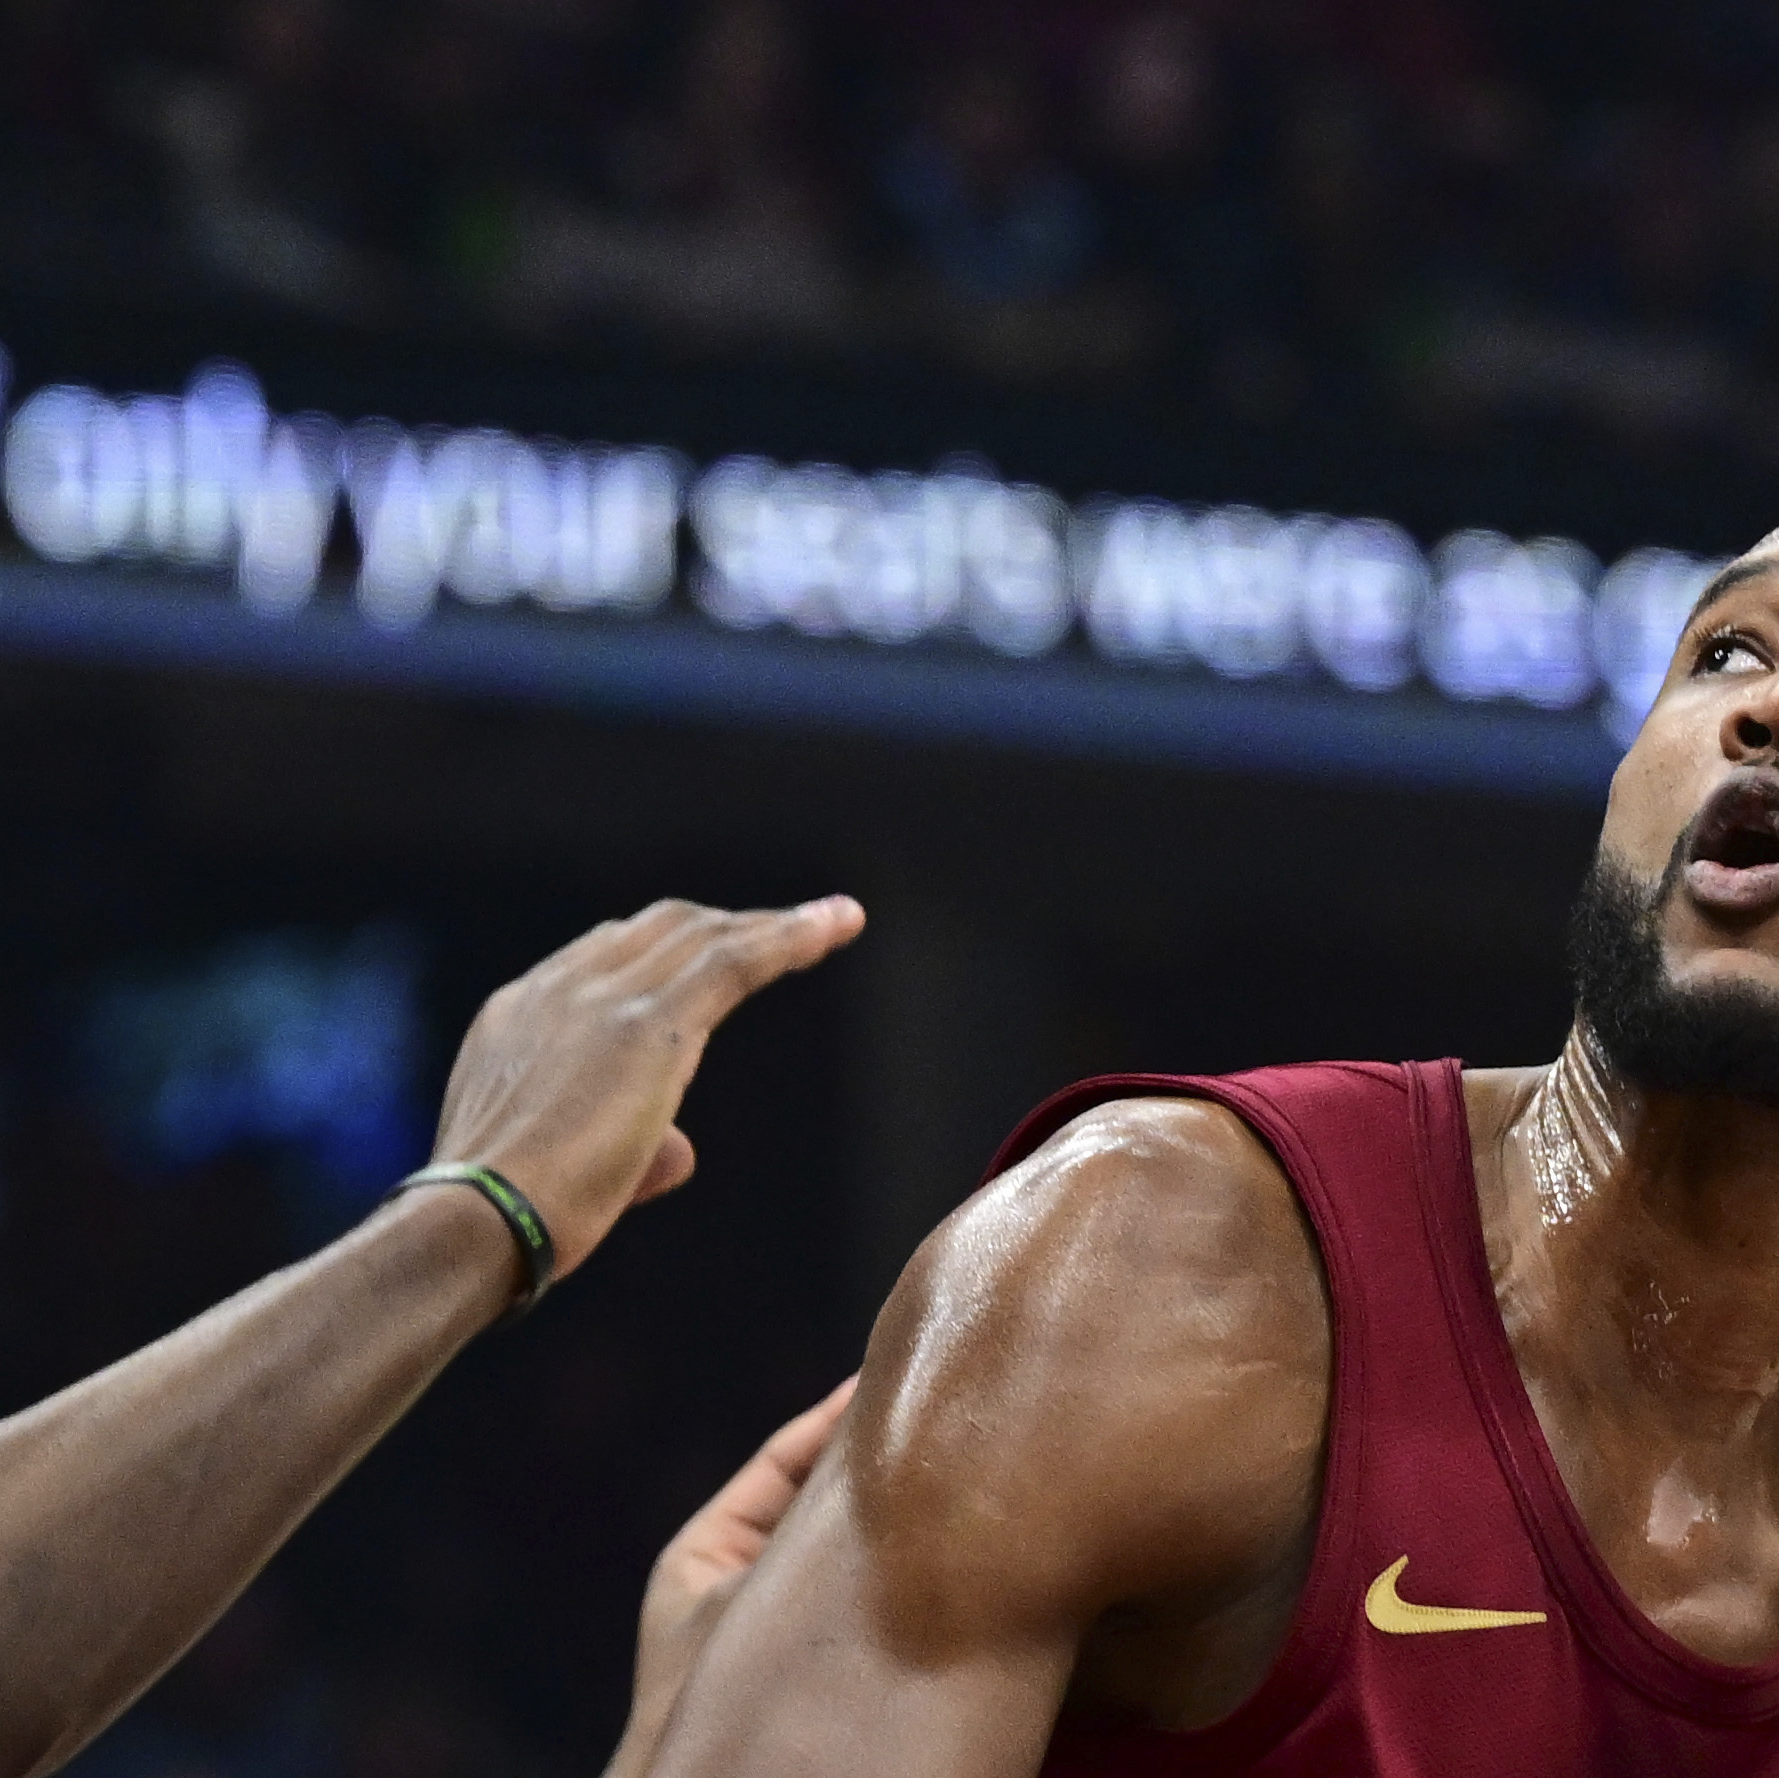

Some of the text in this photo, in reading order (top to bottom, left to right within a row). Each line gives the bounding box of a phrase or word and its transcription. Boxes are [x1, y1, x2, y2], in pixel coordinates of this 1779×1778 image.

[4, 360, 334, 612] only
[350, 418, 680, 628] your
[688, 455, 1072, 656] seats
[1077, 495, 1422, 690] were
